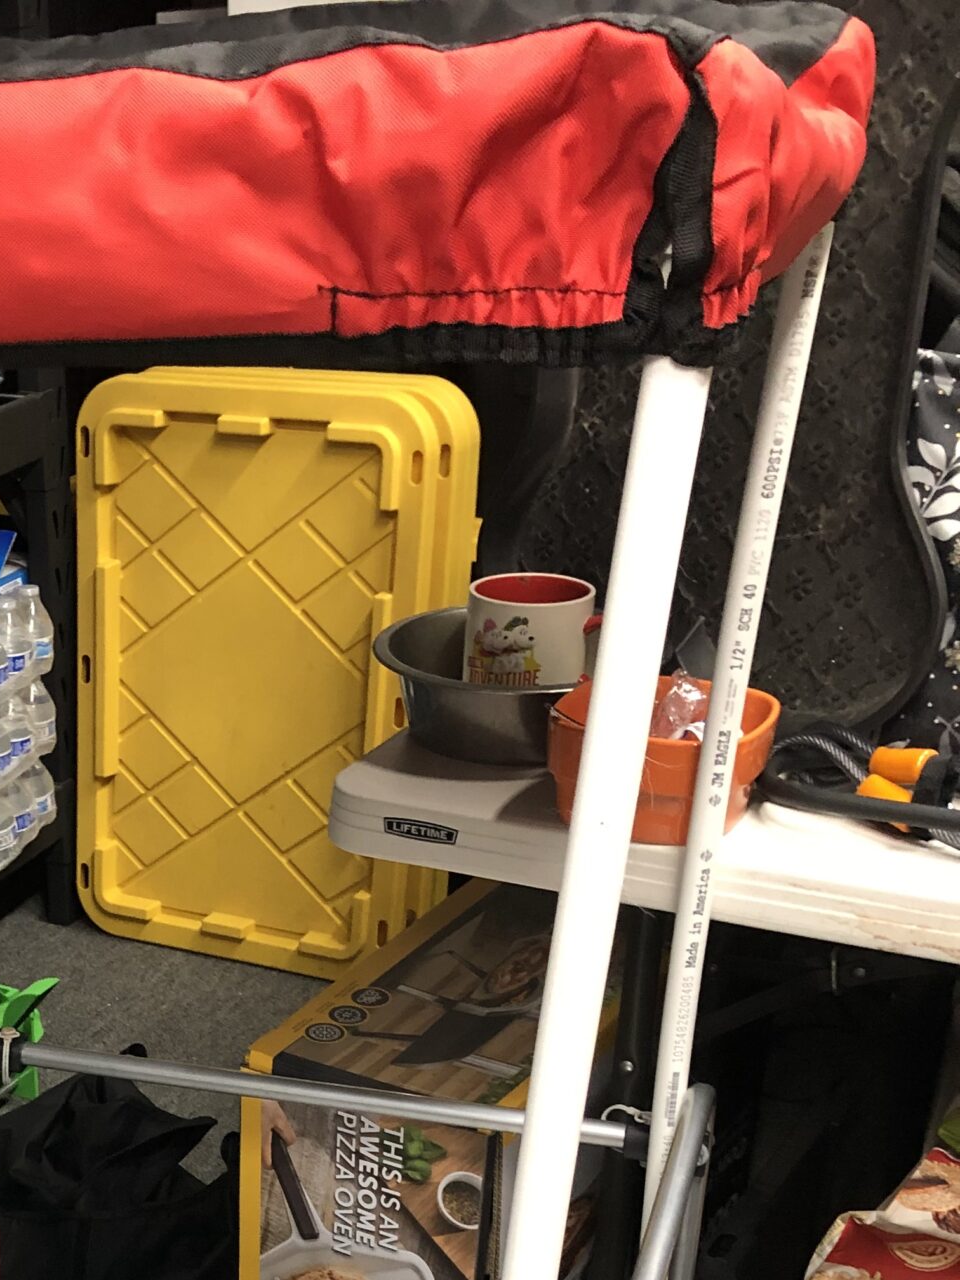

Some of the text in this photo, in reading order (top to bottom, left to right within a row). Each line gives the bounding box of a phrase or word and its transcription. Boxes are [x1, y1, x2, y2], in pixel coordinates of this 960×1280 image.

[742, 581, 758, 603] 40
[738, 608, 754, 633] SCH
[713, 729, 732, 769] EAGLE
[711, 771, 725, 788] JM
[393, 822, 448, 840] LIFETIME
[695, 867, 712, 916] America
[692, 920, 703, 935] in
[684, 941, 699, 970] Made
[331, 1110, 357, 1258] PIZZA OVEN
[354, 1115, 381, 1249] AWESOME
[378, 1126, 405, 1253] THIS IS AN
